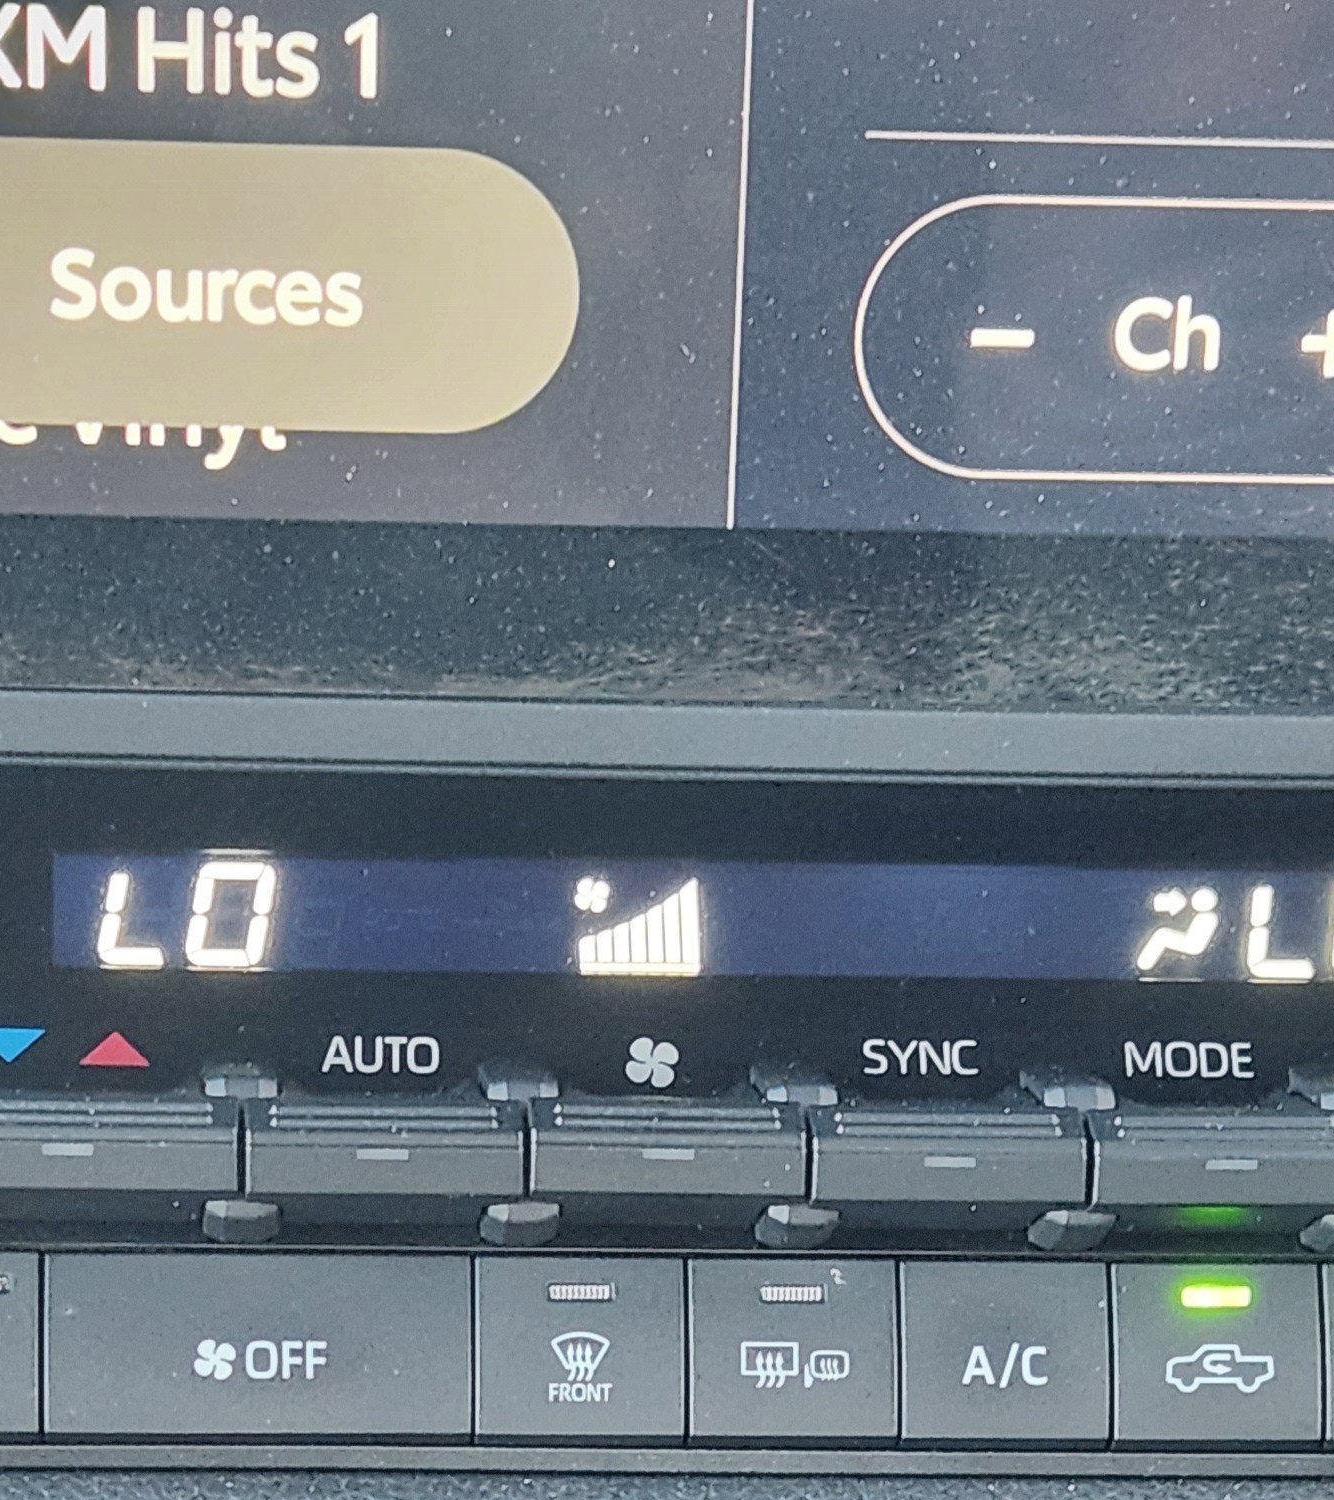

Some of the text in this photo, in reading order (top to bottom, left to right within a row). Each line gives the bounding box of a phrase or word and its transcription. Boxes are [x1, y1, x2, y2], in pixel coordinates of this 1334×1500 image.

[136, 6, 321, 99] Hits
[343, 12, 379, 99] 1
[50, 247, 364, 328] Sources
[1114, 294, 1222, 372] Ch
[96, 861, 277, 970] LO
[321, 1035, 440, 1075] AUTO
[862, 1038, 979, 1076] SYNC
[1124, 1040, 1255, 1079] MODE
[244, 1339, 328, 1380] OFF
[961, 1341, 1049, 1389] A/C
[547, 1382, 613, 1403] FRONT
